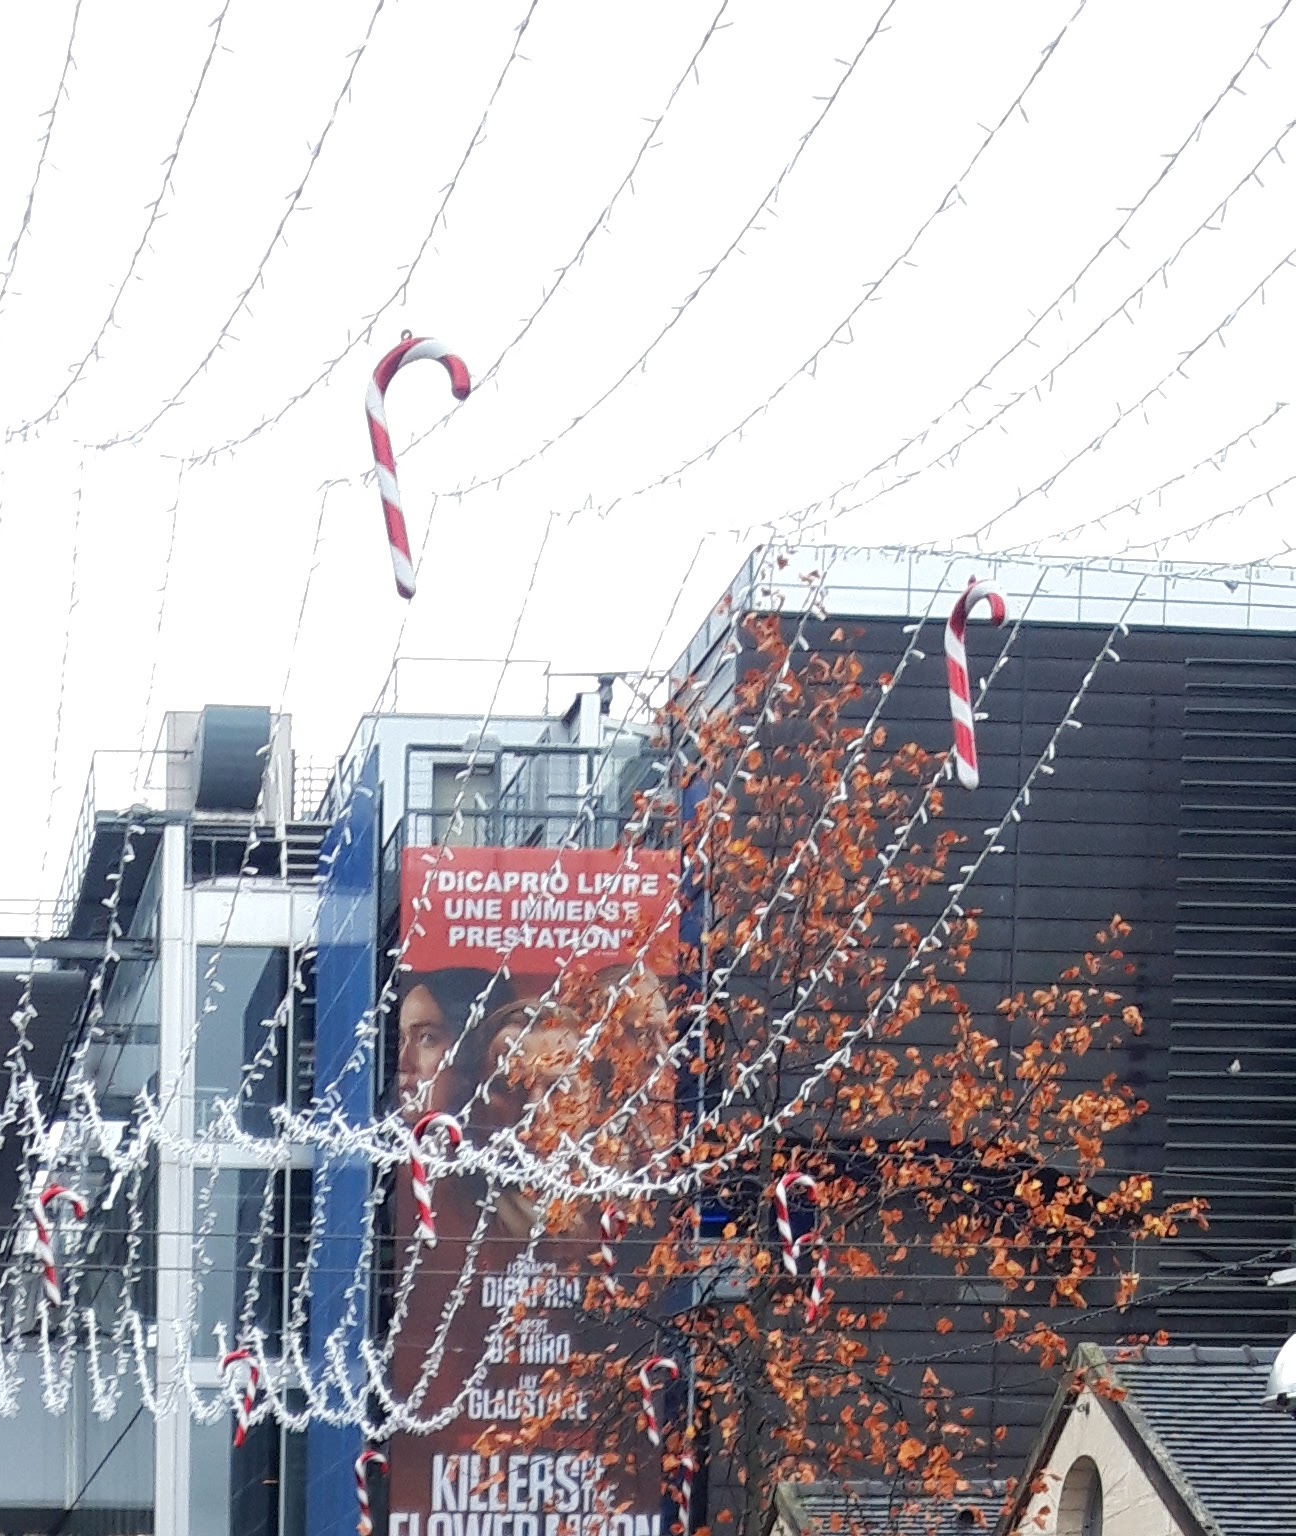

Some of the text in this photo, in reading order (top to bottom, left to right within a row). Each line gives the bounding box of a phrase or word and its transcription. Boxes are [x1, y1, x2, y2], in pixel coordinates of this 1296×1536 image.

[577, 872, 659, 896] LIVRE
[444, 897, 639, 923] UNE IMMENSE
[432, 1453, 579, 1512] KILLERS
